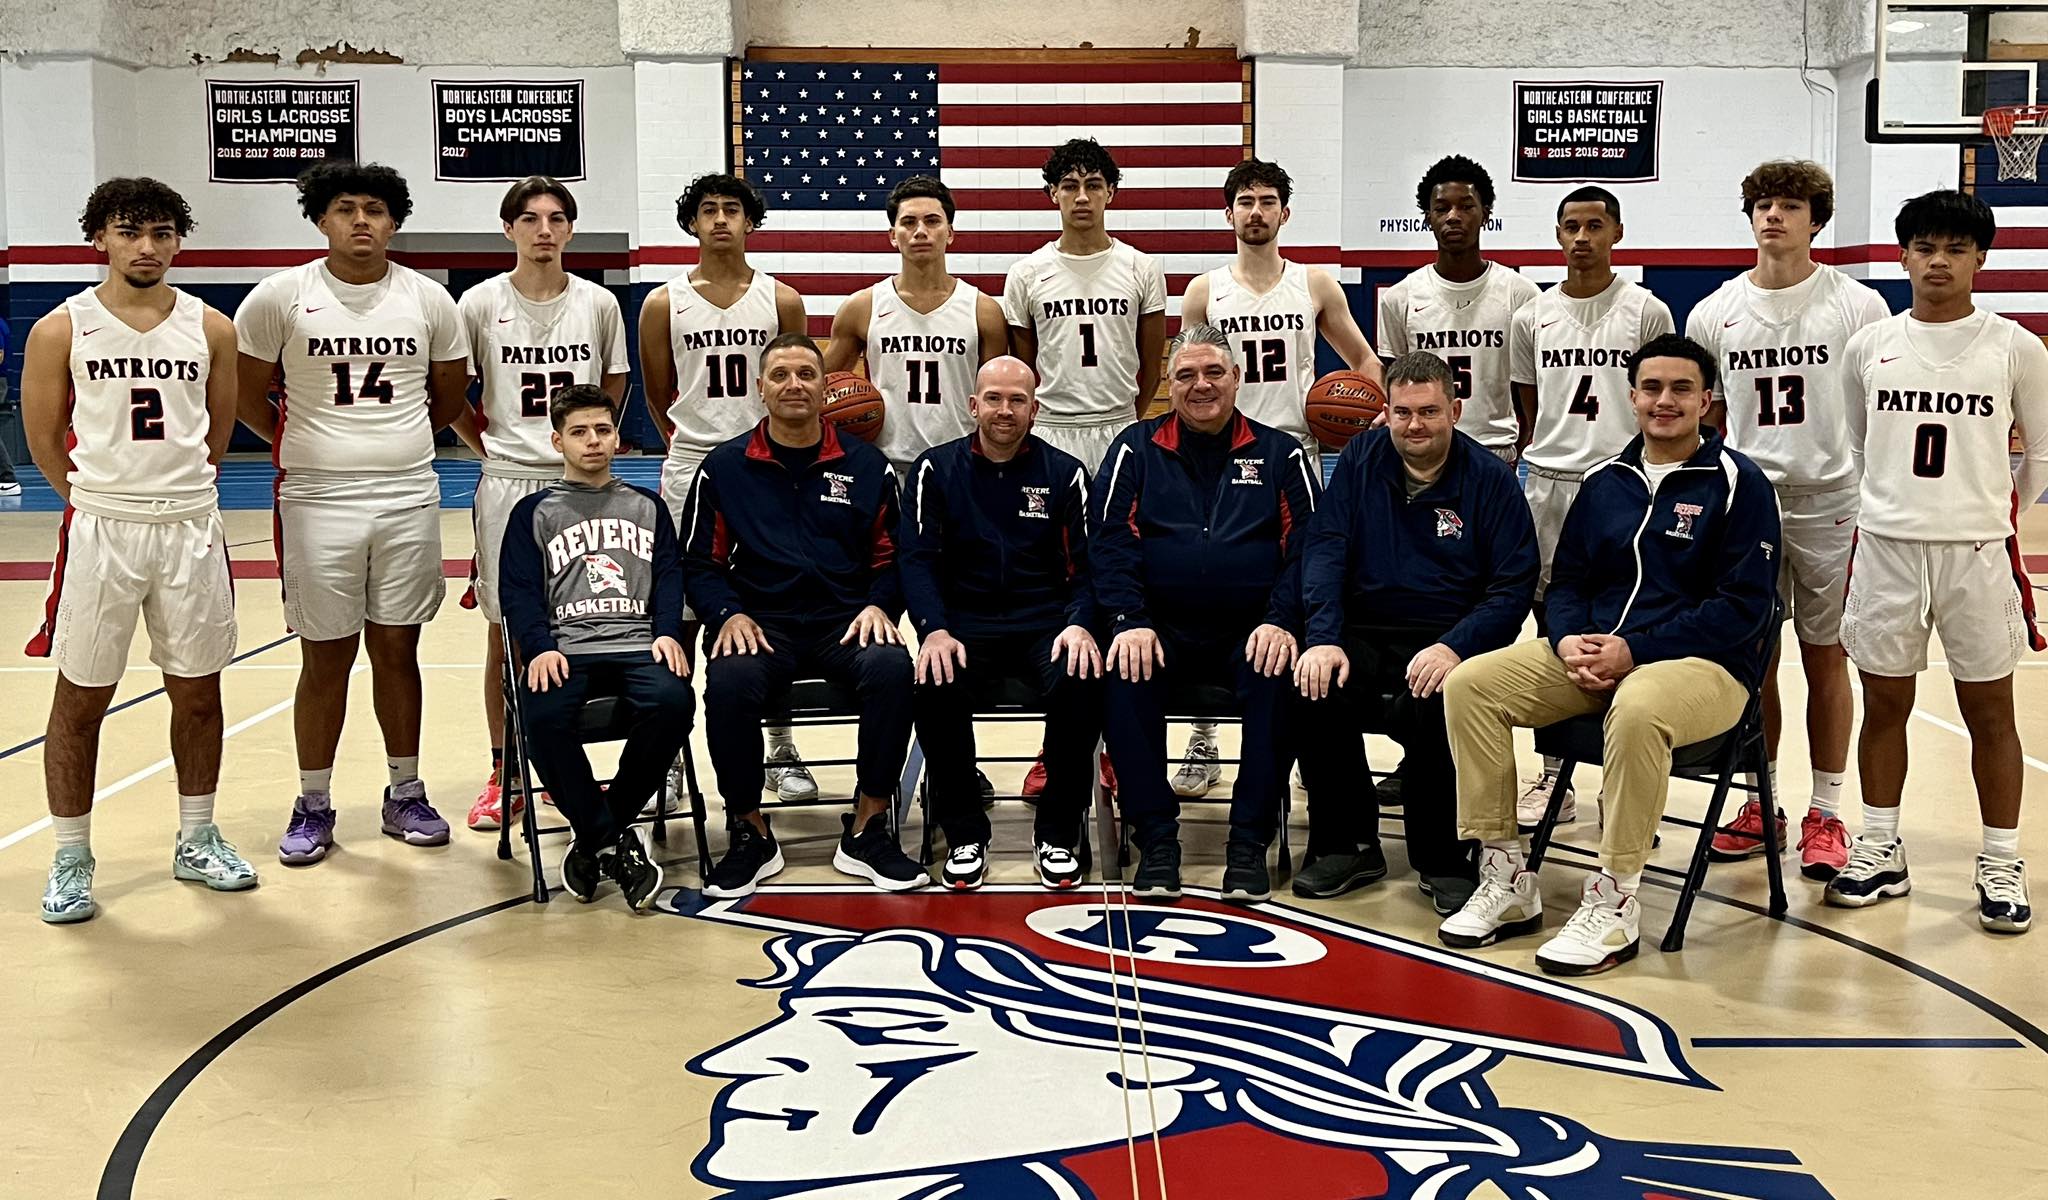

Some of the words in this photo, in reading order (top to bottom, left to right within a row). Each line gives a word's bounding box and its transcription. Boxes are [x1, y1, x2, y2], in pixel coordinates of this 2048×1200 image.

[215, 89, 287, 105] NORTHEASTERN
[292, 89, 351, 105] CONFERENCE
[442, 89, 512, 105] NORTHEASTERN
[517, 89, 574, 105] CONFERENCE
[1524, 90, 1592, 105] NORTHEASTERN
[1596, 90, 1653, 105] CONFERENCE
[216, 109, 262, 124] GIRLS
[268, 108, 351, 124] LACROSSE
[445, 109, 486, 123] BOYS
[491, 108, 573, 123] LACROSSE
[1527, 109, 1563, 124] GIRLS
[1567, 109, 1648, 124] BASKETBALL
[231, 128, 337, 143] CHAMPIONS
[457, 128, 562, 143] CHAMPIONS
[1535, 128, 1639, 143] CHAMPIONS
[217, 148, 242, 158] 2016
[245, 148, 269, 158] 2017
[272, 147, 297, 158] 2018
[300, 148, 326, 158] 2019
[442, 146, 466, 158] 2017
[1547, 147, 1572, 158] 2015
[1575, 147, 1599, 157] 2016
[1601, 148, 1626, 159] 2017
[1042, 297, 1129, 320] PATRIOTS
[1219, 313, 1304, 336] PATRIOTS
[307, 336, 418, 357] PATRIOTS
[683, 328, 767, 351] PATRIOTS
[880, 335, 966, 356] PATRIOTS
[1079, 323, 1098, 367] 1
[1416, 329, 1504, 350] PATRIOTS
[501, 343, 591, 365] PATRIOTS
[1241, 338, 1287, 384] 12
[1541, 348, 1632, 369] PATRIOTS
[1728, 344, 1829, 371] PATRIOTS
[85, 357, 199, 382] PATRIOTS
[705, 353, 748, 399] 10
[1447, 355, 1472, 400] 5
[330, 361, 394, 406] 14
[905, 359, 942, 405] 11
[1567, 374, 1600, 421] 4
[1754, 374, 1806, 427] 13
[1876, 389, 1994, 418] PATRIOTS
[130, 387, 165, 441] 2
[1912, 422, 1948, 479] 0
[822, 471, 854, 483] REVERE
[547, 518, 655, 576] REVERE
[555, 597, 647, 621] BASKETBAL
